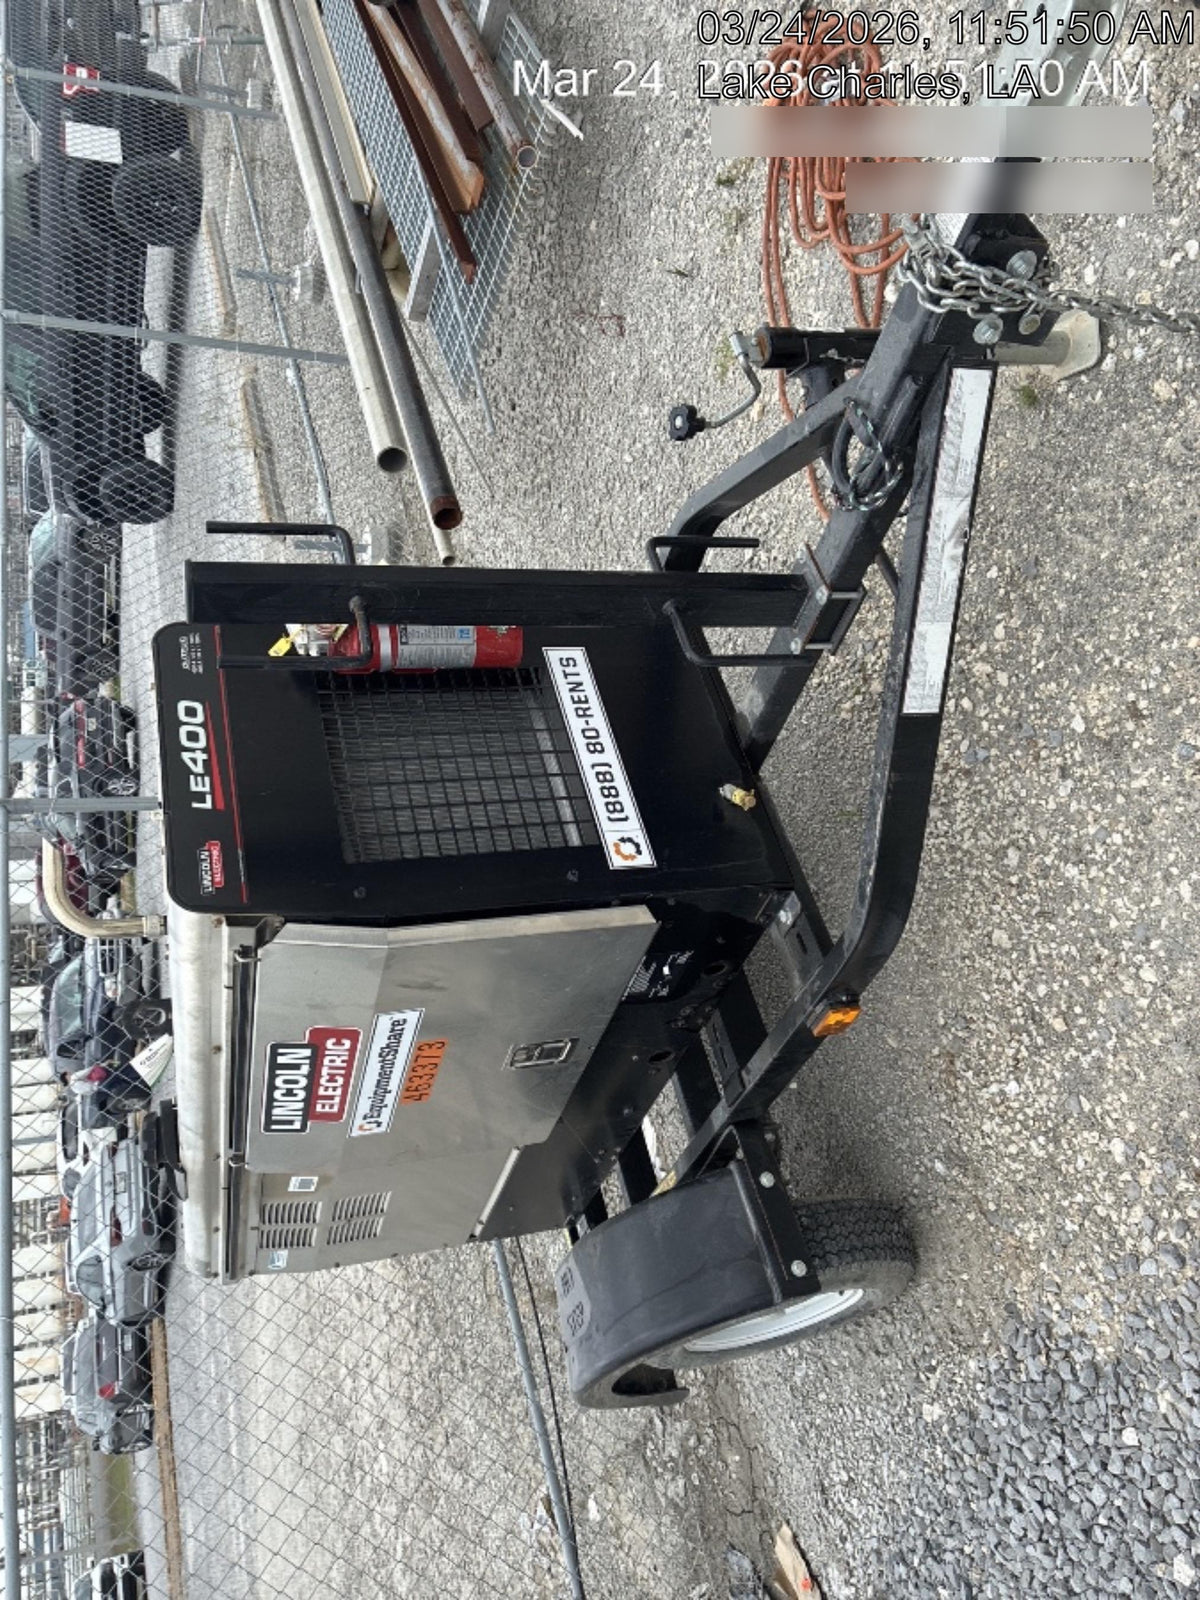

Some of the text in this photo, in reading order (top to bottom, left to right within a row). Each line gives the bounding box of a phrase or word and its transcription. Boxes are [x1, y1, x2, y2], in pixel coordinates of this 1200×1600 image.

[177, 699, 213, 810] LE400
[559, 656, 629, 823] (888) 80-RENTS
[200, 851, 212, 893] LINCOLN
[270, 1048, 312, 1130] LINCOLN
[315, 1037, 351, 1114] ELECTRIC
[363, 1017, 407, 1121] EquipmentShare
[402, 1040, 446, 1102] 463373
